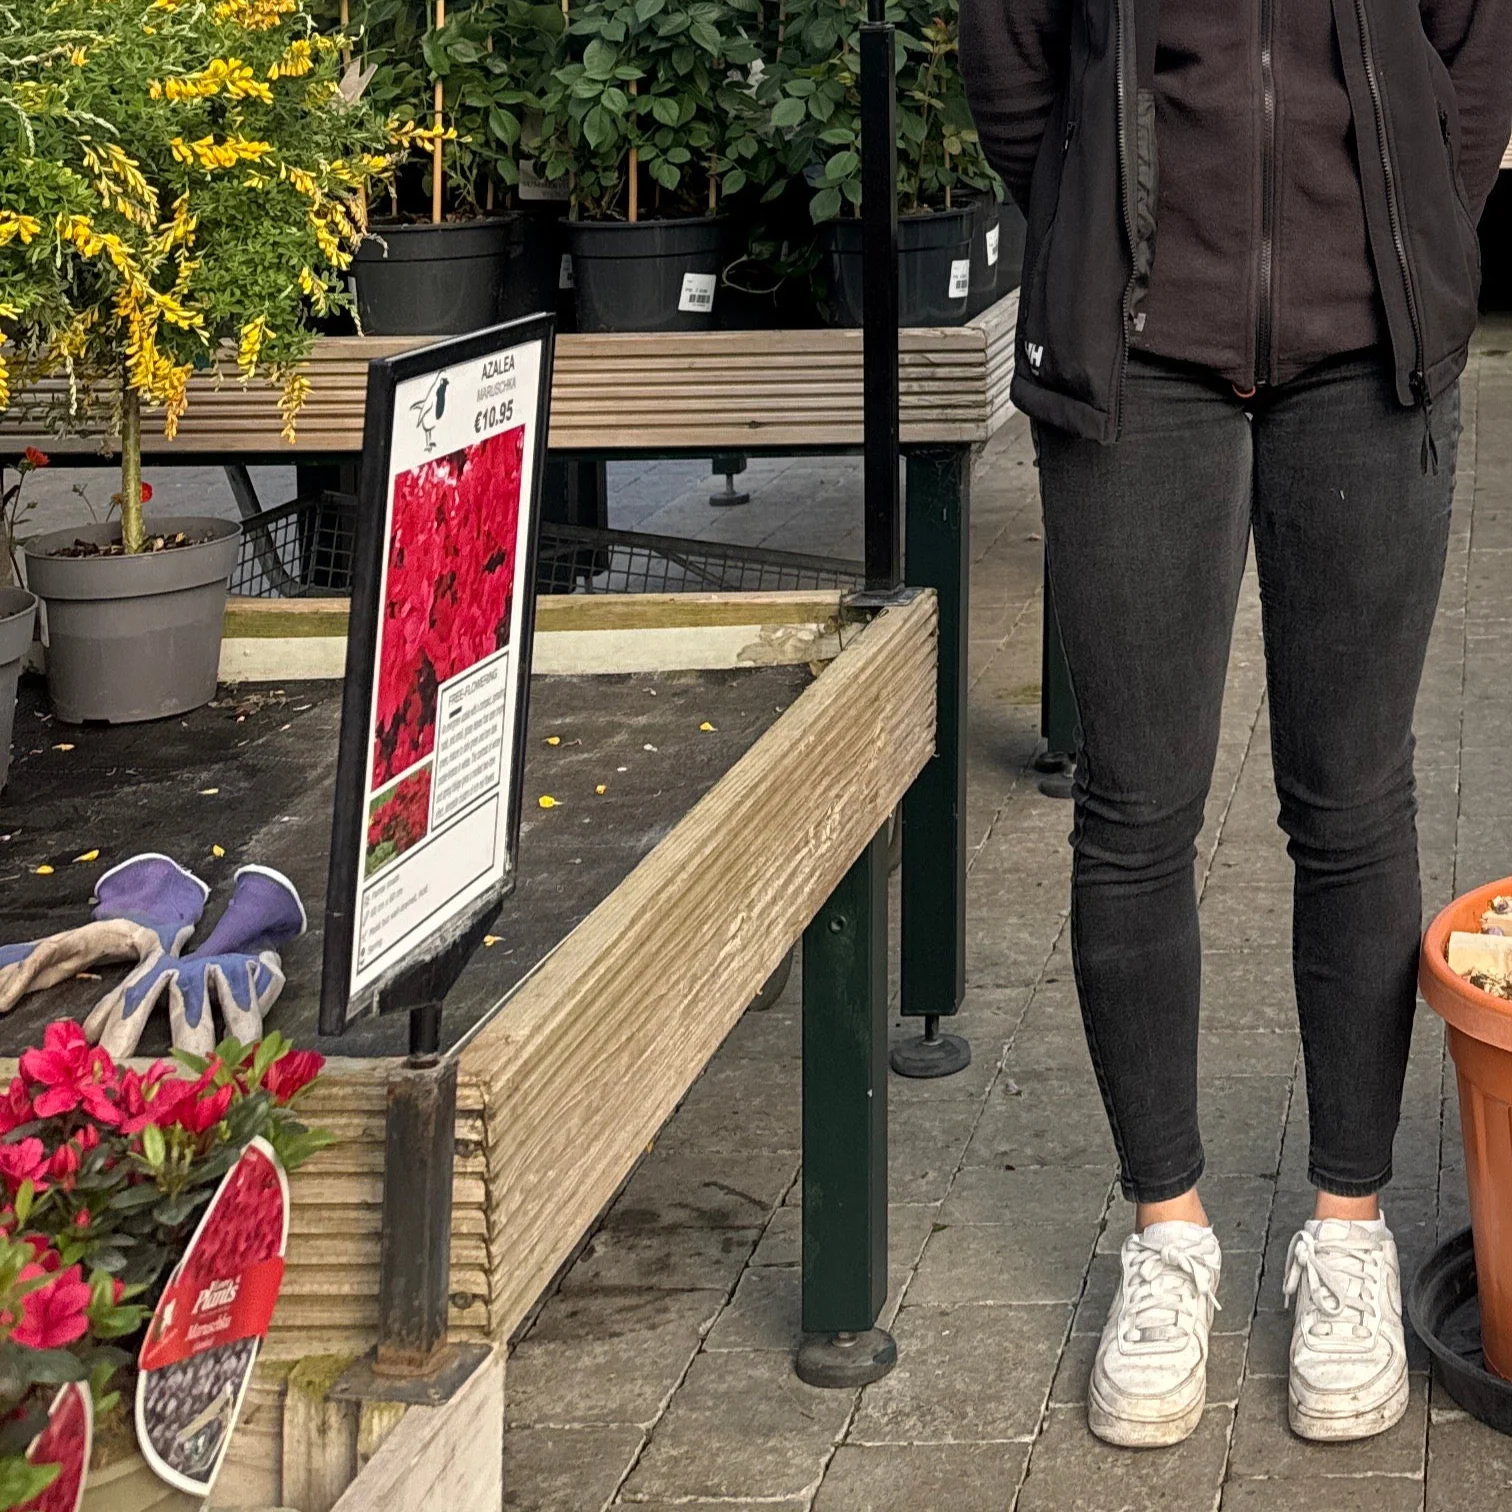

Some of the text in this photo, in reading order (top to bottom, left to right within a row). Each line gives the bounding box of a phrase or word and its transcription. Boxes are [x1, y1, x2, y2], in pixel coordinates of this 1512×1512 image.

[481, 354, 515, 380] AZALEA
[476, 377, 517, 402] MARUSCHKA
[474, 398, 514, 434] €10.95
